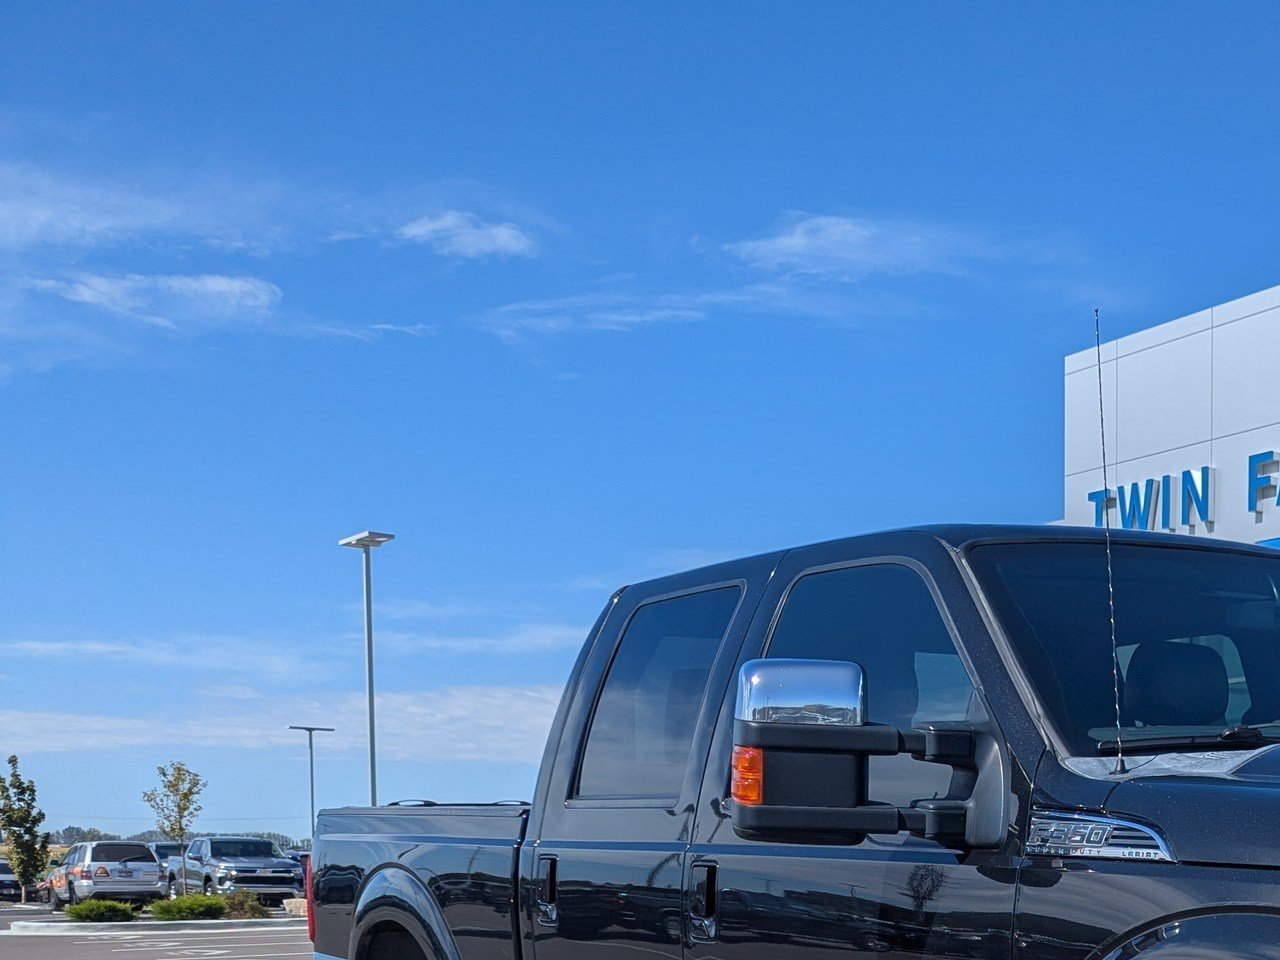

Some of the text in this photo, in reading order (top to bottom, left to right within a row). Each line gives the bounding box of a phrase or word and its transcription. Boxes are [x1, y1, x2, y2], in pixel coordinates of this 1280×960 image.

[1088, 466, 1213, 531] TWIN
[1069, 847, 1103, 856] DUTY
[1121, 850, 1160, 859] LARIAT
